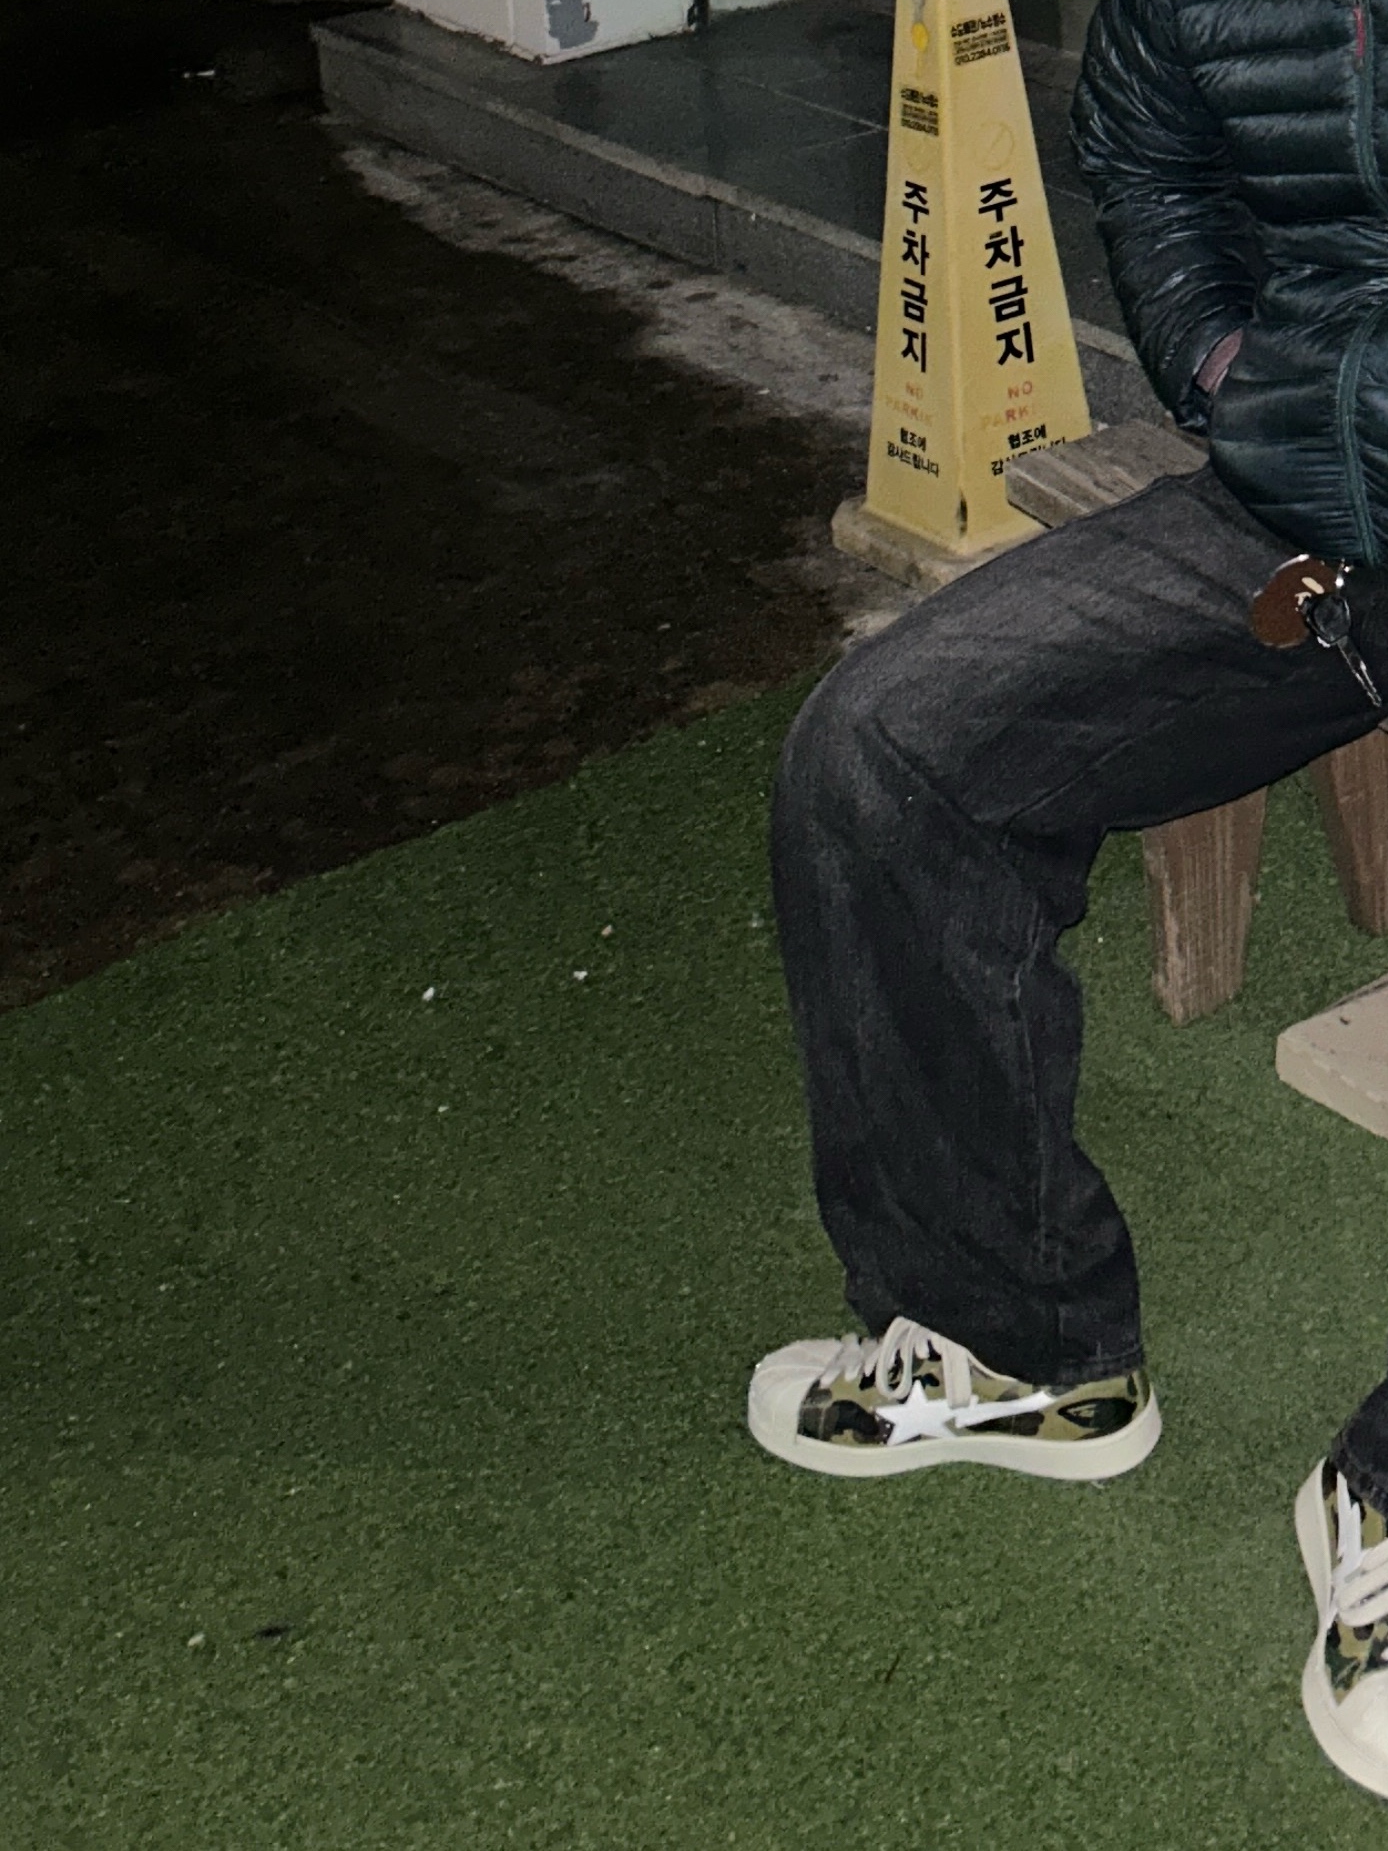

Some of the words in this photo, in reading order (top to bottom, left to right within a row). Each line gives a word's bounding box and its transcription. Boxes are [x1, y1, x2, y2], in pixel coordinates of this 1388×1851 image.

[901, 180, 930, 373] 주차금지
[978, 177, 1035, 366] 주차금지
[906, 381, 923, 400] NO
[1008, 380, 1033, 400] NO
[901, 427, 926, 453] 협조에
[1008, 423, 1047, 449] 협조에
[888, 441, 939, 478] 감사드립니다
